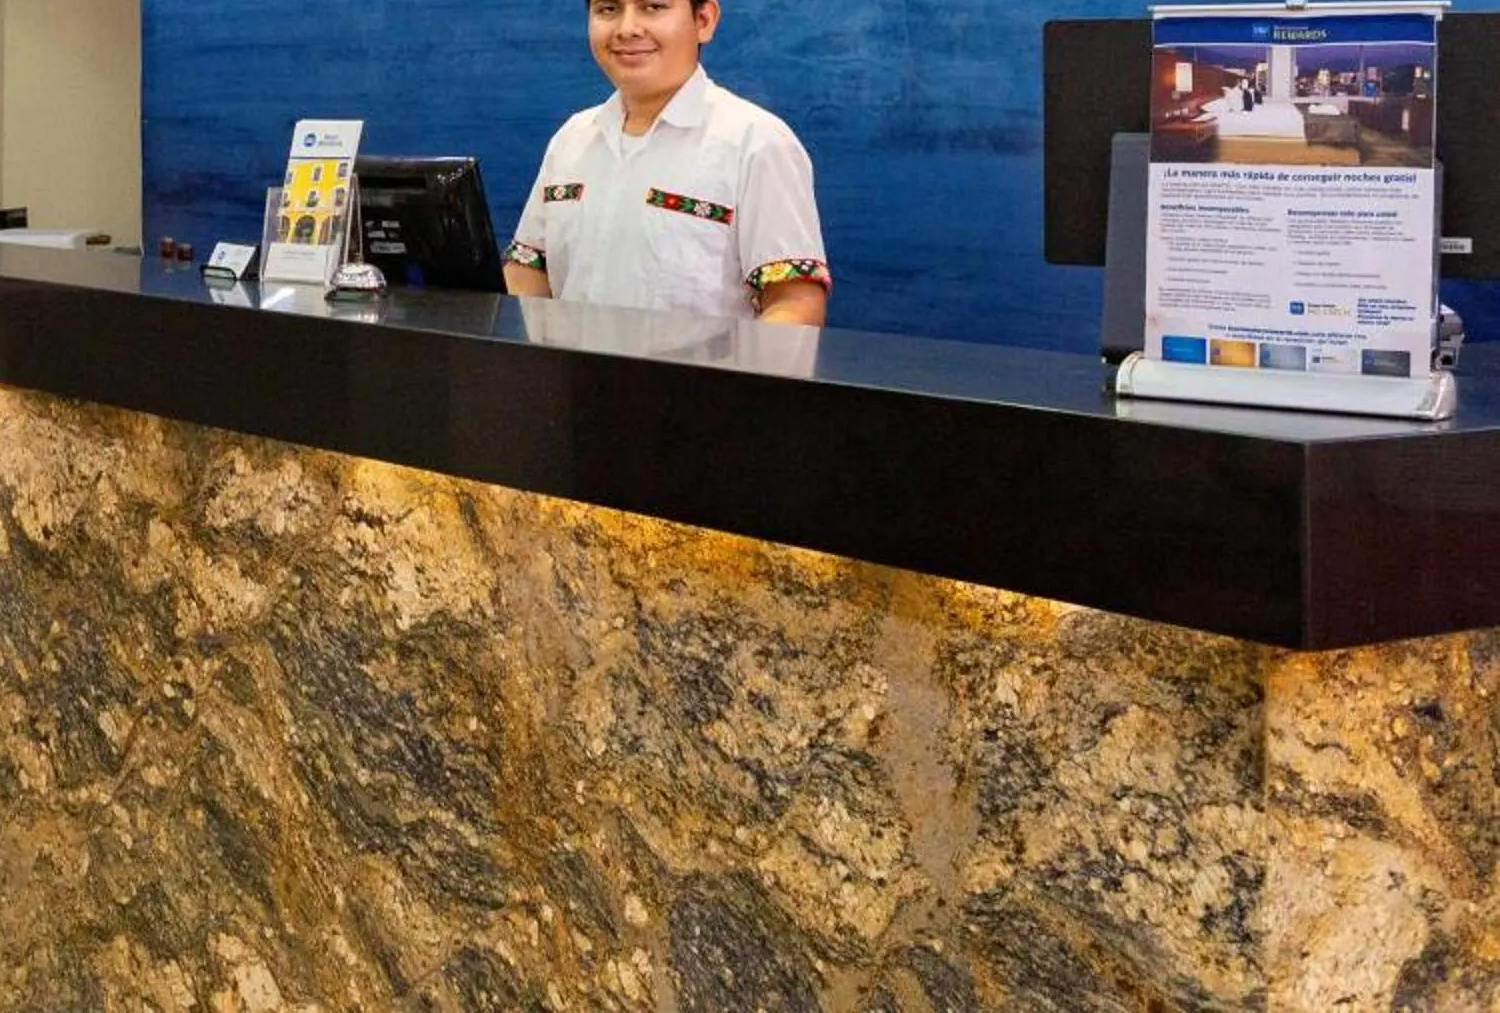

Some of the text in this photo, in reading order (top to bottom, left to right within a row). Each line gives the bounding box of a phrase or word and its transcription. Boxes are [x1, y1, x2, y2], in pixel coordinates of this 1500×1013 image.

[1182, 170, 1217, 178] manera
[1278, 171, 1290, 181] de
[1292, 172, 1341, 184] conseguir
[1343, 172, 1380, 182] noches
